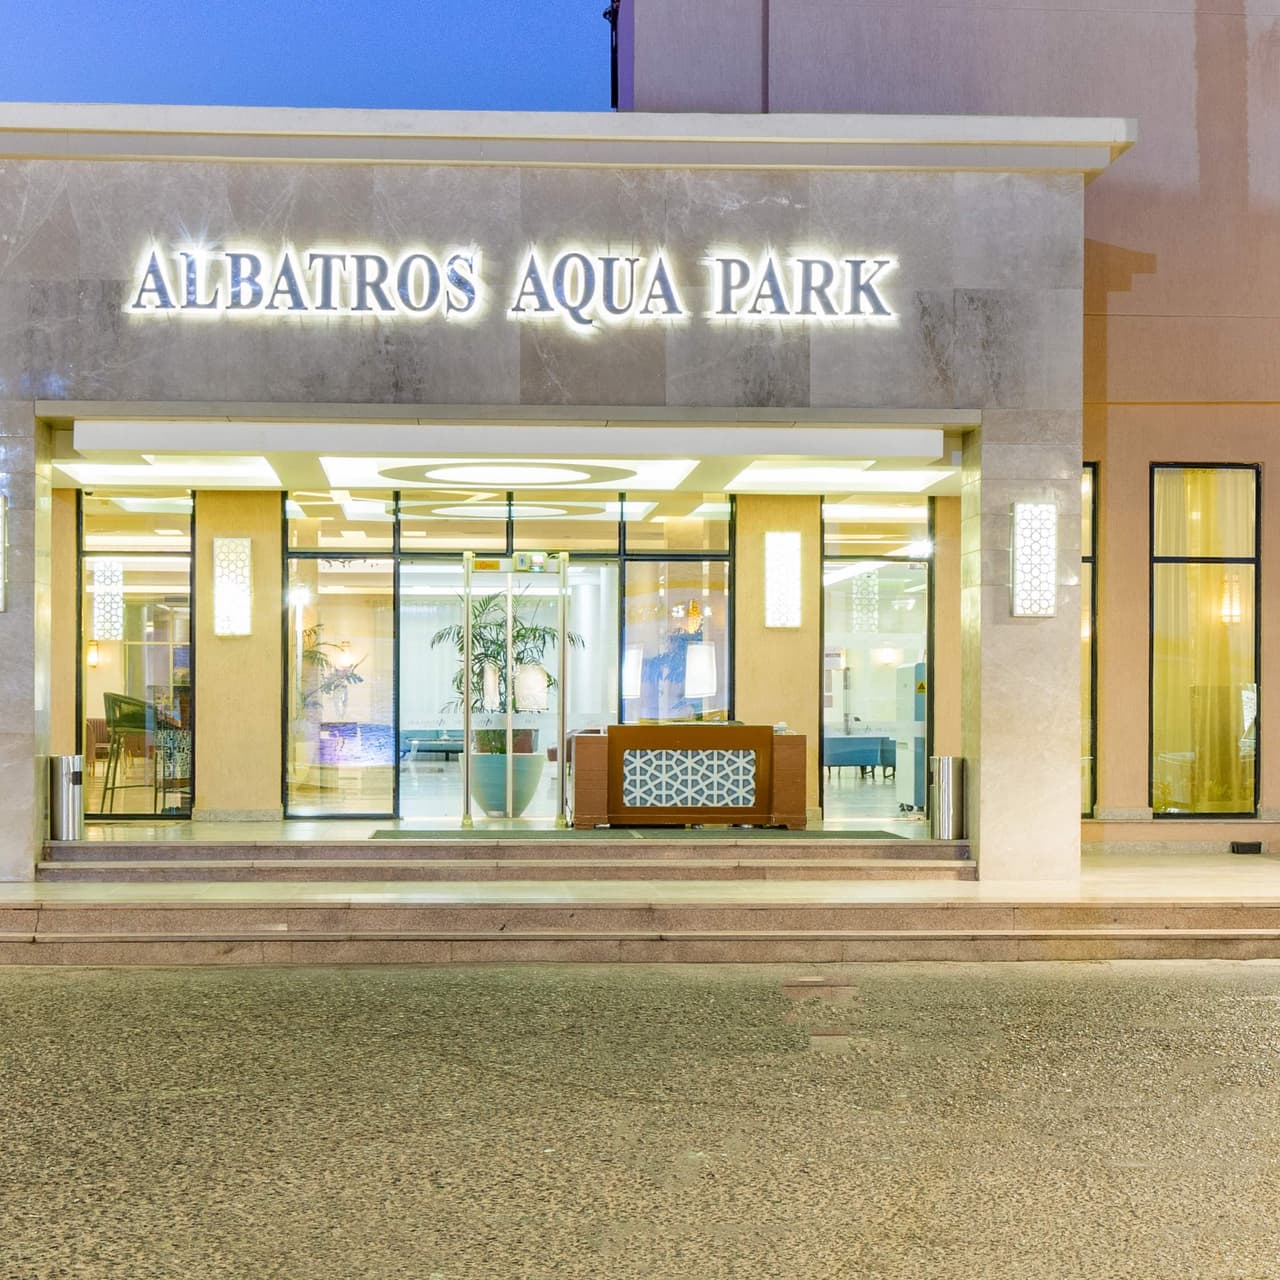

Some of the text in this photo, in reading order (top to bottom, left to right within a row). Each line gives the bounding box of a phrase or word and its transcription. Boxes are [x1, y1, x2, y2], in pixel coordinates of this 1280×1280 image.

[131, 251, 892, 325] ALBATROS AQUA PARK
